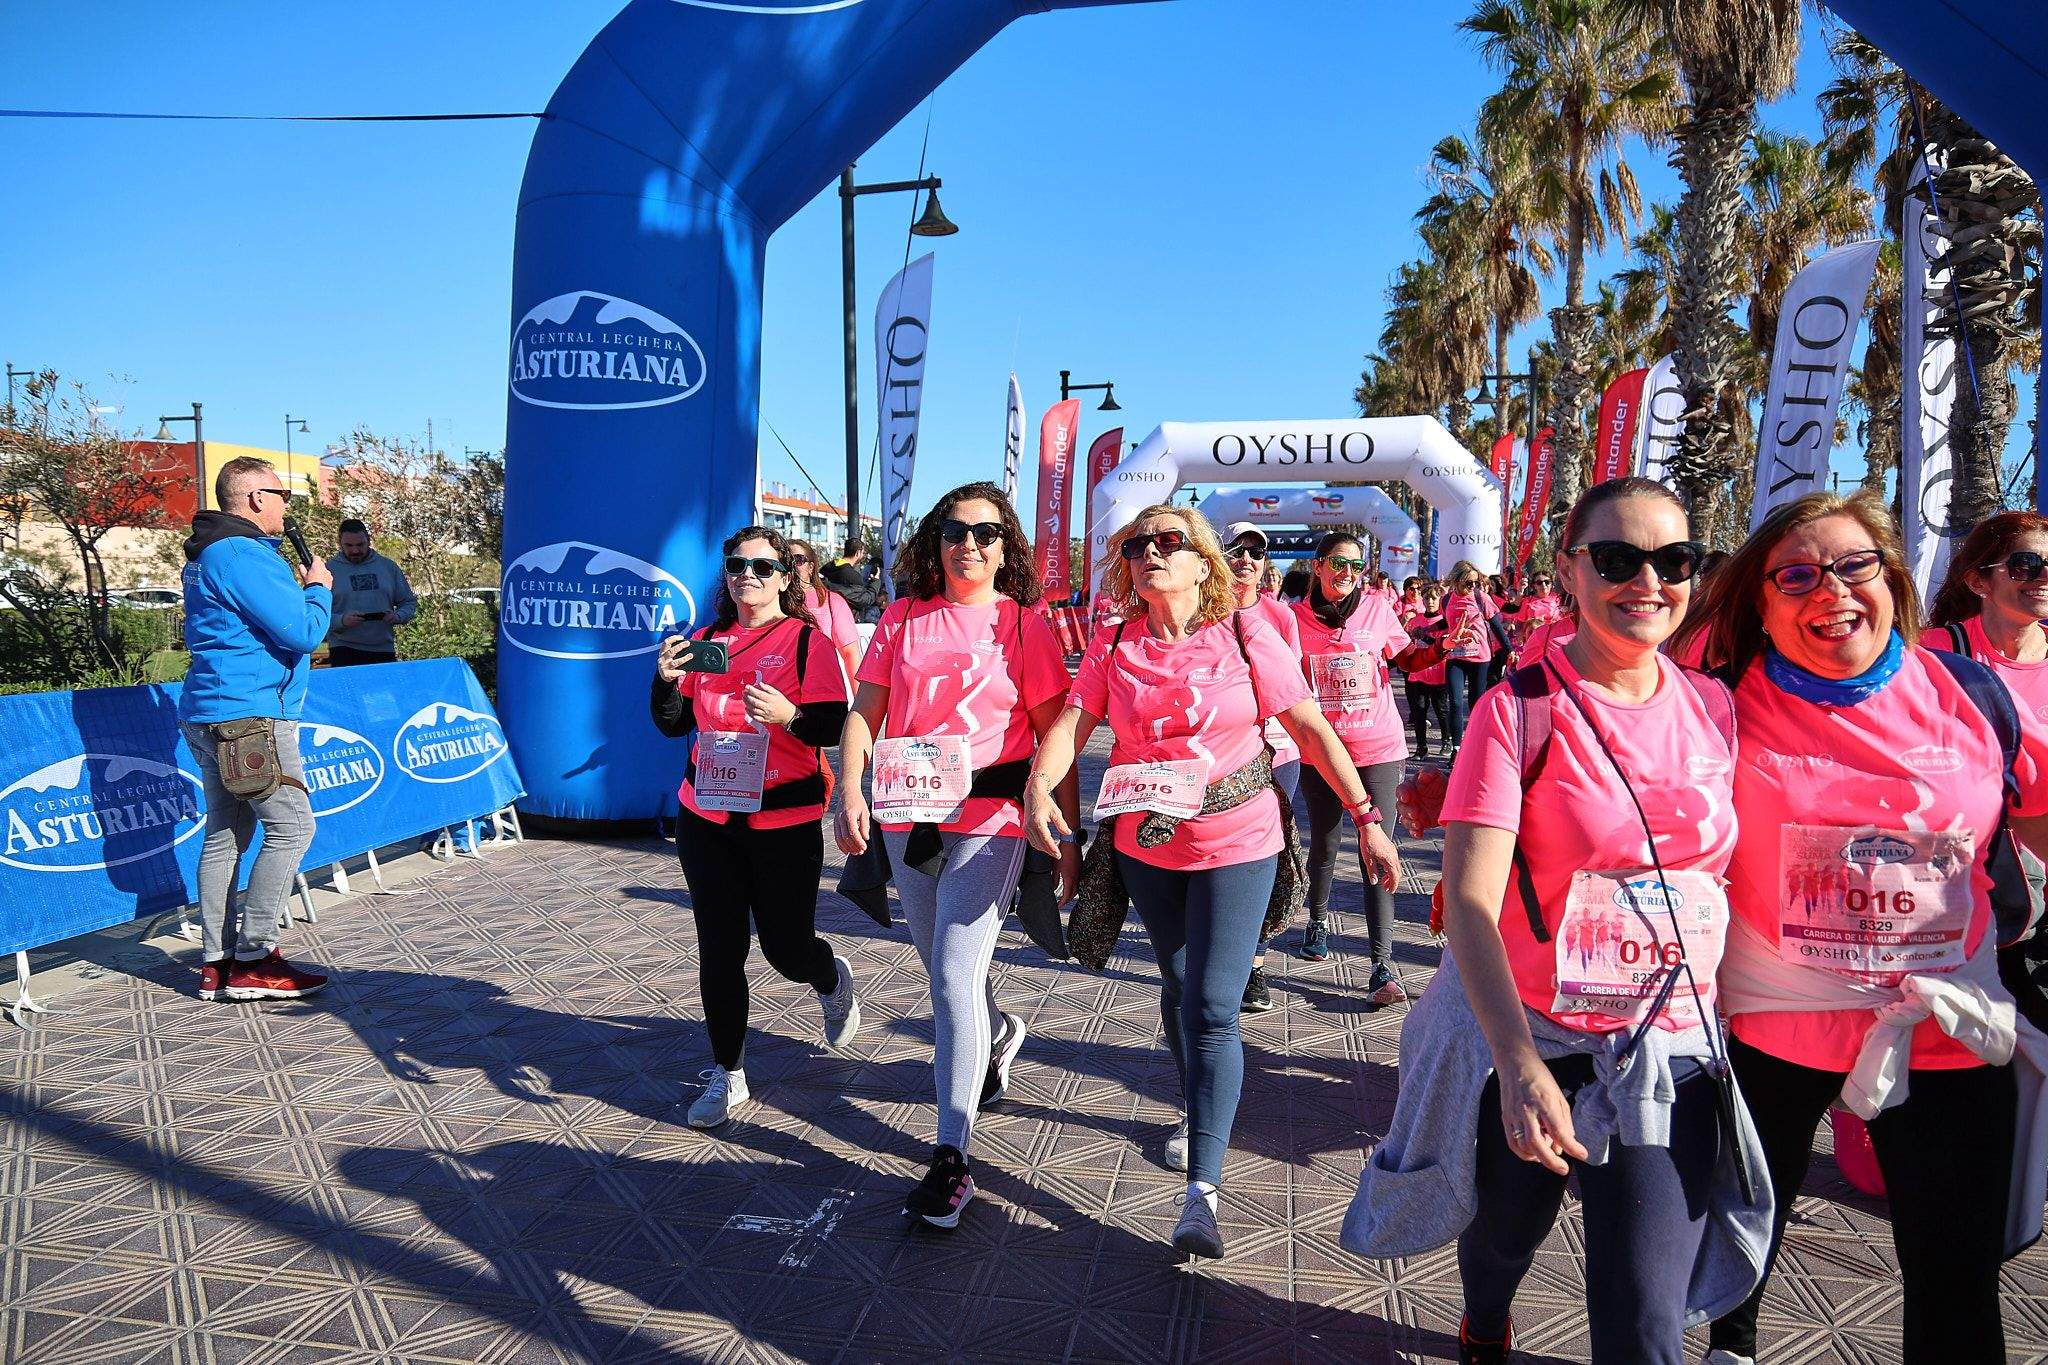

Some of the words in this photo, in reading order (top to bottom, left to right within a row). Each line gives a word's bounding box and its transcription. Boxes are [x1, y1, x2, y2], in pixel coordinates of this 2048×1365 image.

[530, 331, 594, 345] CENTRAL
[602, 332, 683, 352] LECHERA
[513, 338, 690, 388] ASTURIANA
[1764, 295, 1848, 519] YSHO
[886, 316, 926, 550] OYSHO
[1606, 398, 1628, 481] ntander
[1212, 431, 1376, 467] OYSHO
[1049, 423, 1068, 511] Santander
[1099, 451, 1112, 481] der
[1423, 466, 1474, 477] OYSHO
[1497, 456, 1507, 482] der
[1118, 471, 1165, 483] OYSHO
[1525, 446, 1550, 521] Santander
[1449, 534, 1497, 546] OYSHO
[1043, 537, 1062, 589] Sports
[521, 580, 584, 593] CENTRAL
[592, 583, 672, 599] LECHERA
[504, 582, 679, 632] ASTURIANA
[1333, 678, 1357, 689] 016
[1334, 721, 1344, 729] DE
[322, 745, 366, 760] LECHERA
[405, 731, 504, 769] ASTURIANA
[302, 757, 378, 793] URIANA
[712, 766, 737, 780] 016
[905, 775, 942, 790] 016
[34, 790, 108, 813] CENTRAL
[117, 779, 185, 799] LECHERA
[1134, 783, 1173, 794] 016
[4, 794, 202, 855] ASTURIANA
[882, 809, 913, 819] OYSHO
[1846, 848, 1909, 858] ASTURIANA
[1618, 891, 1680, 907] ASTURIAA
[1846, 888, 1916, 914] 016
[1859, 920, 1893, 931] 8329
[1803, 929, 1842, 941] CARRERA
[1845, 933, 1856, 942] DE
[1858, 933, 1869, 942] LA
[1871, 934, 1901, 944] MUJER
[1907, 934, 1946, 943] VALENCIA
[1619, 940, 1683, 966] 016
[1800, 944, 1859, 961] OYSHO
[1896, 949, 1946, 962] Santander
[1580, 984, 1618, 996] CARRERA
[1619, 987, 1632, 996] DE
